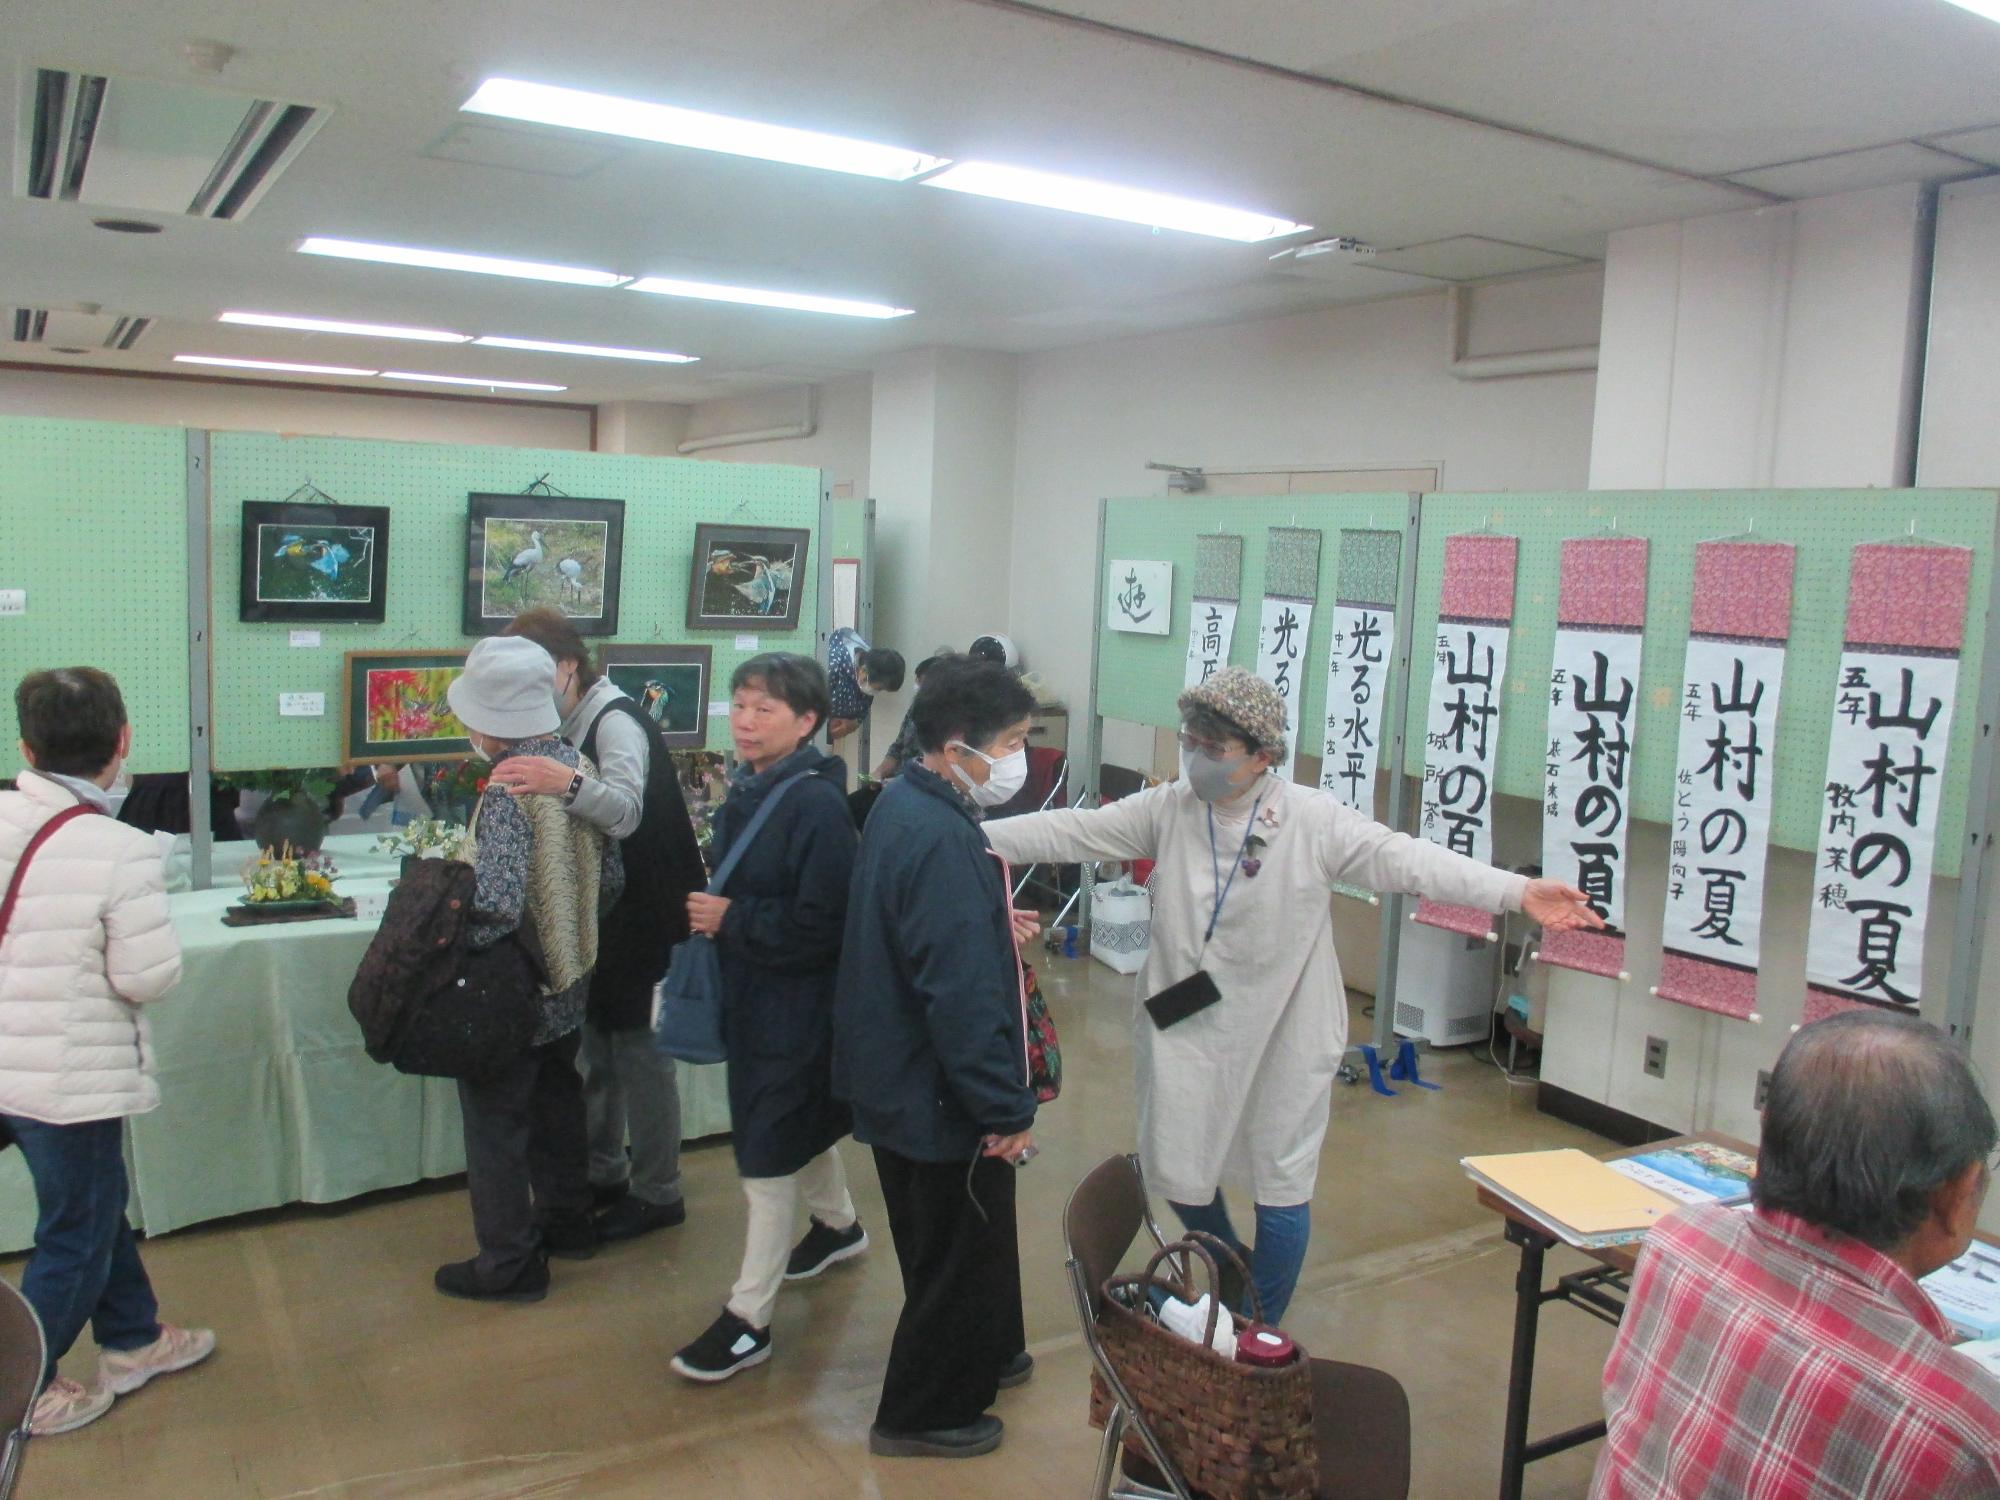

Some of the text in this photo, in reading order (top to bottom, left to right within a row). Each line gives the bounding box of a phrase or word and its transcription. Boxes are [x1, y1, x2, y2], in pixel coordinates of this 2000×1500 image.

[1331, 630, 1344, 678] 中一年
[1551, 669, 1567, 706] 五年
[1683, 684, 1702, 721] 五年
[1838, 667, 1871, 725] 五年
[1339, 611, 1382, 810] 光る水平
[1424, 732, 1448, 844] 城所蒼
[1570, 650, 1634, 931] 山村の夏
[1690, 658, 1764, 946] 山村の夏
[1838, 667, 1942, 1004] 山村の夏
